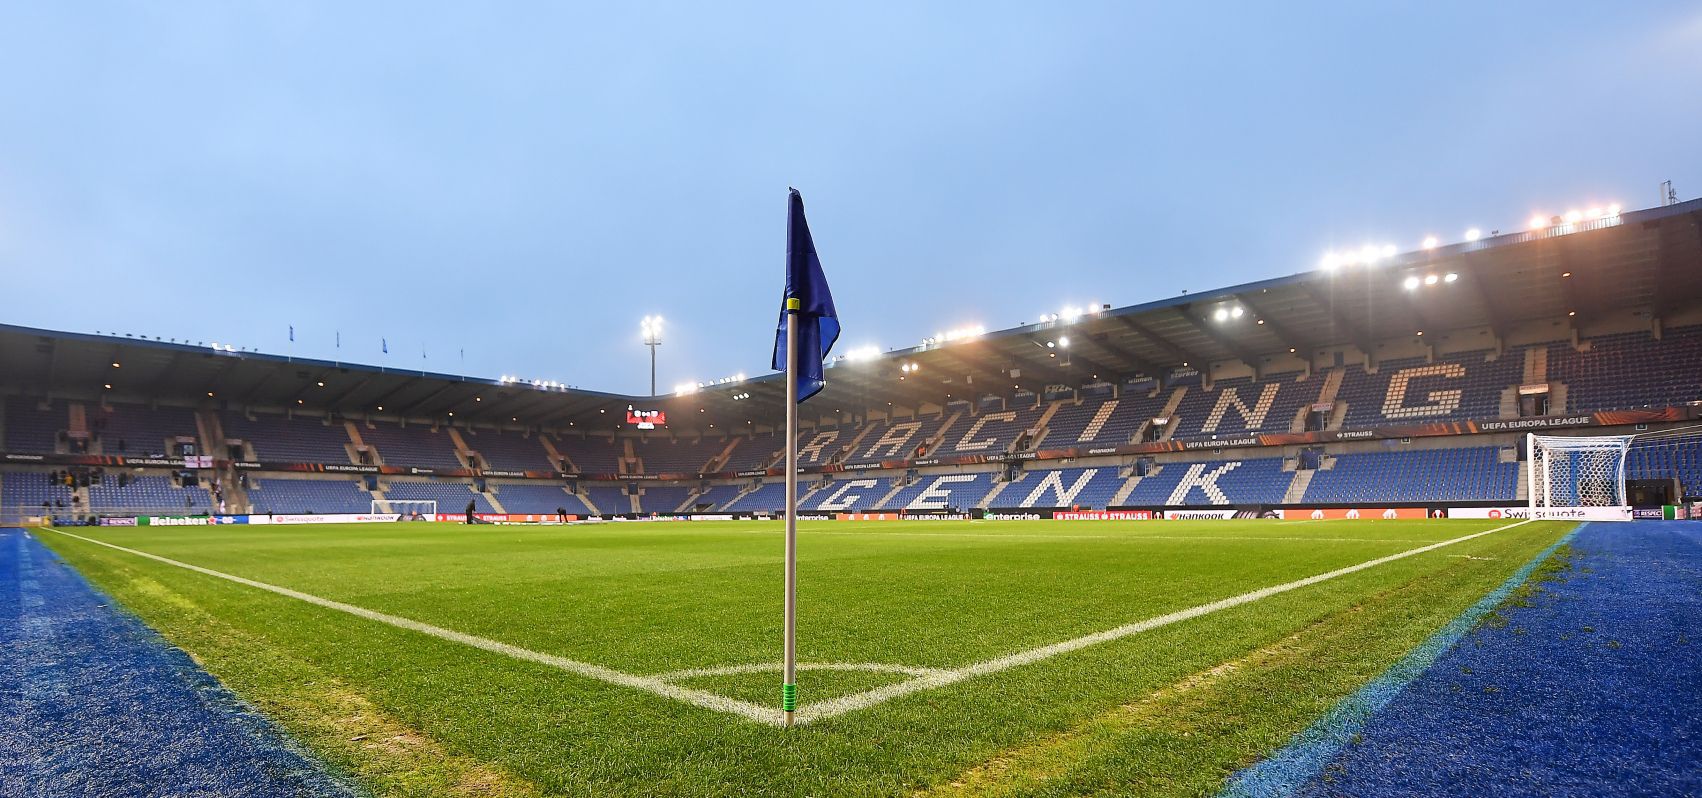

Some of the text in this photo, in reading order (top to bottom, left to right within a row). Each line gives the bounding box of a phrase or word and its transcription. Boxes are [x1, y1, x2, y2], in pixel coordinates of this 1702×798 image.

[1508, 420, 1547, 428] EUROPA
[1549, 417, 1589, 426] LEAGUE
[1343, 430, 1373, 438] STRAUSS
[1186, 441, 1203, 449] UEFA
[1230, 438, 1256, 446] LEAGUE
[817, 462, 1241, 511] GENK
[149, 516, 208, 525] Heineken
[985, 512, 1040, 520] enterprise
[1110, 512, 1147, 520] STRAUSS
